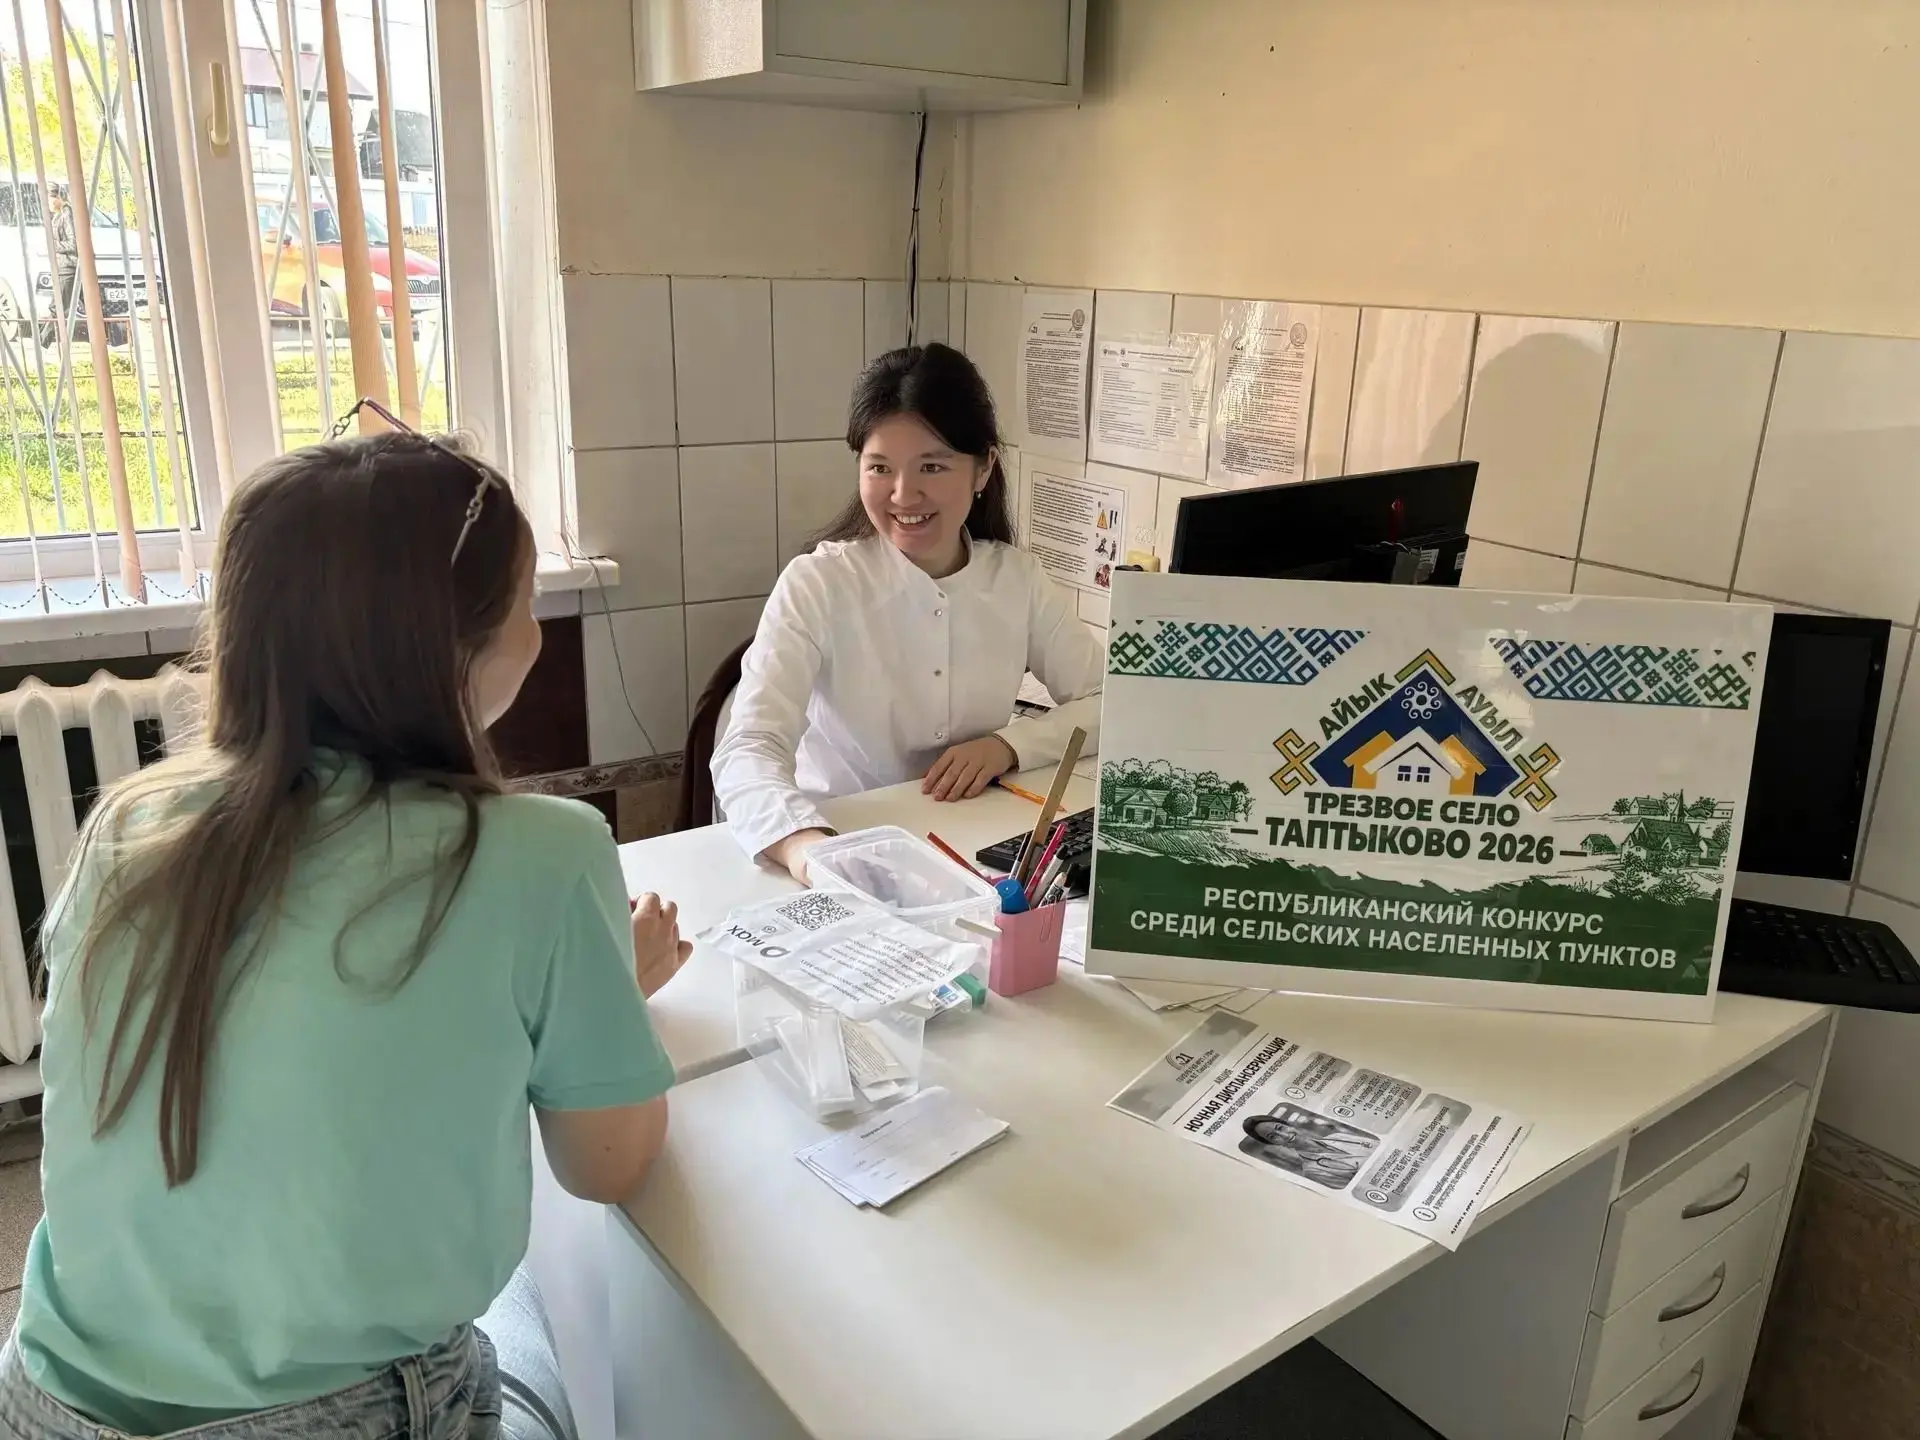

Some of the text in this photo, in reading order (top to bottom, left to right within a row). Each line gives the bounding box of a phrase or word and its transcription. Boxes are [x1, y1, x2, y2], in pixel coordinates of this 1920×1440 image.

[1319, 672, 1524, 752] АЙЫК АУЫЛ
[1305, 791, 1520, 827] ТРЕЗВОЕ СЕЛО
[1266, 817, 1554, 864] ТАПТЫКОВО 2026
[1205, 886, 1603, 936] РЕСПУБЛИКАНСКИЙ КОНКУРС
[1130, 910, 1676, 970] СРЕДИ СЕЛЬСКИХ НАСЕЛЕННЫХ ПУНКТОВ
[1182, 1036, 1291, 1132] НОЧНАЯ ДИСПАНСЕРИЗАЦИЯ
[1213, 1068, 1233, 1084] АКЦИЯ
